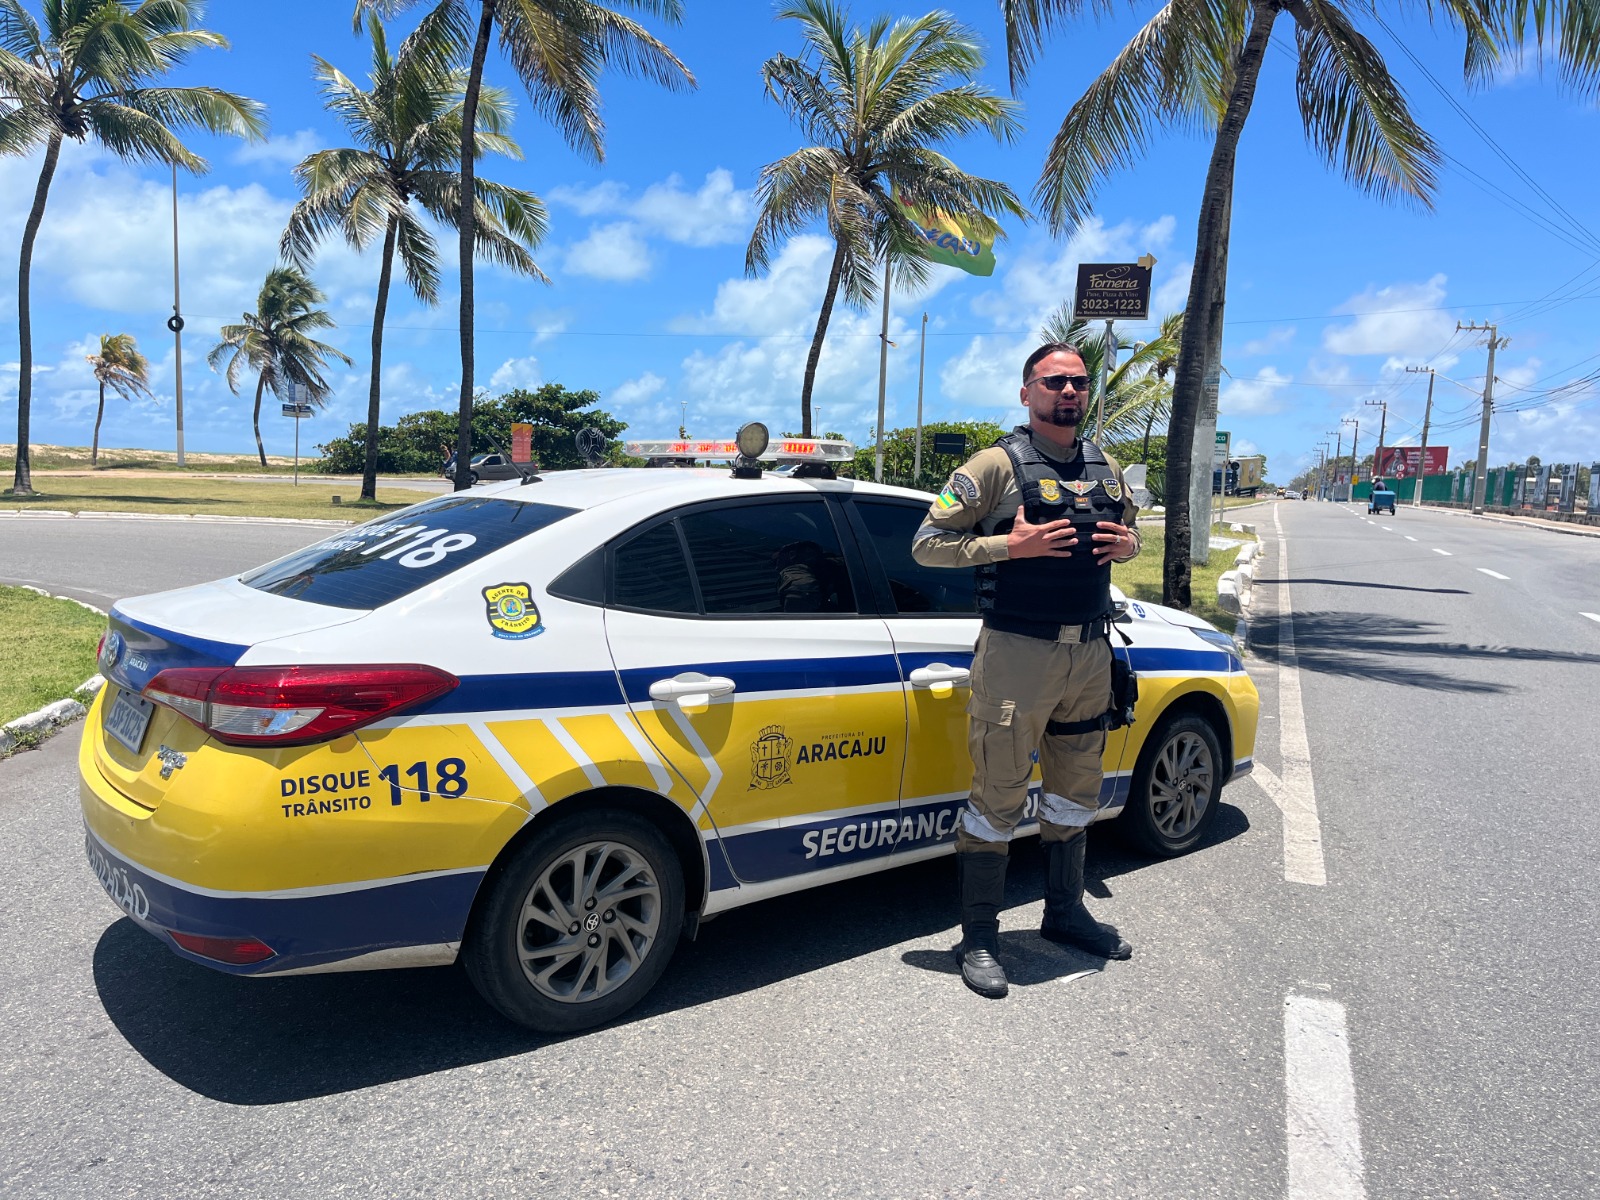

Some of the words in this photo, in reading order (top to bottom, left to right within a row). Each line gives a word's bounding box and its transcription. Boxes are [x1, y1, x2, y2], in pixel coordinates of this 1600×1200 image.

[1089, 274, 1138, 288] Forneria
[1081, 299, 1142, 310] 3023-1223
[360, 525, 477, 568] 118
[491, 588, 514, 600] AGENTE
[516, 589, 525, 597] DE
[500, 617, 530, 628] TRÂNSITO
[821, 731, 856, 740] PREFEITURA
[796, 736, 886, 765] ARACAJU
[280, 769, 371, 798] DISQUE
[377, 757, 469, 807] 118
[281, 796, 372, 818] TRÂNSITO
